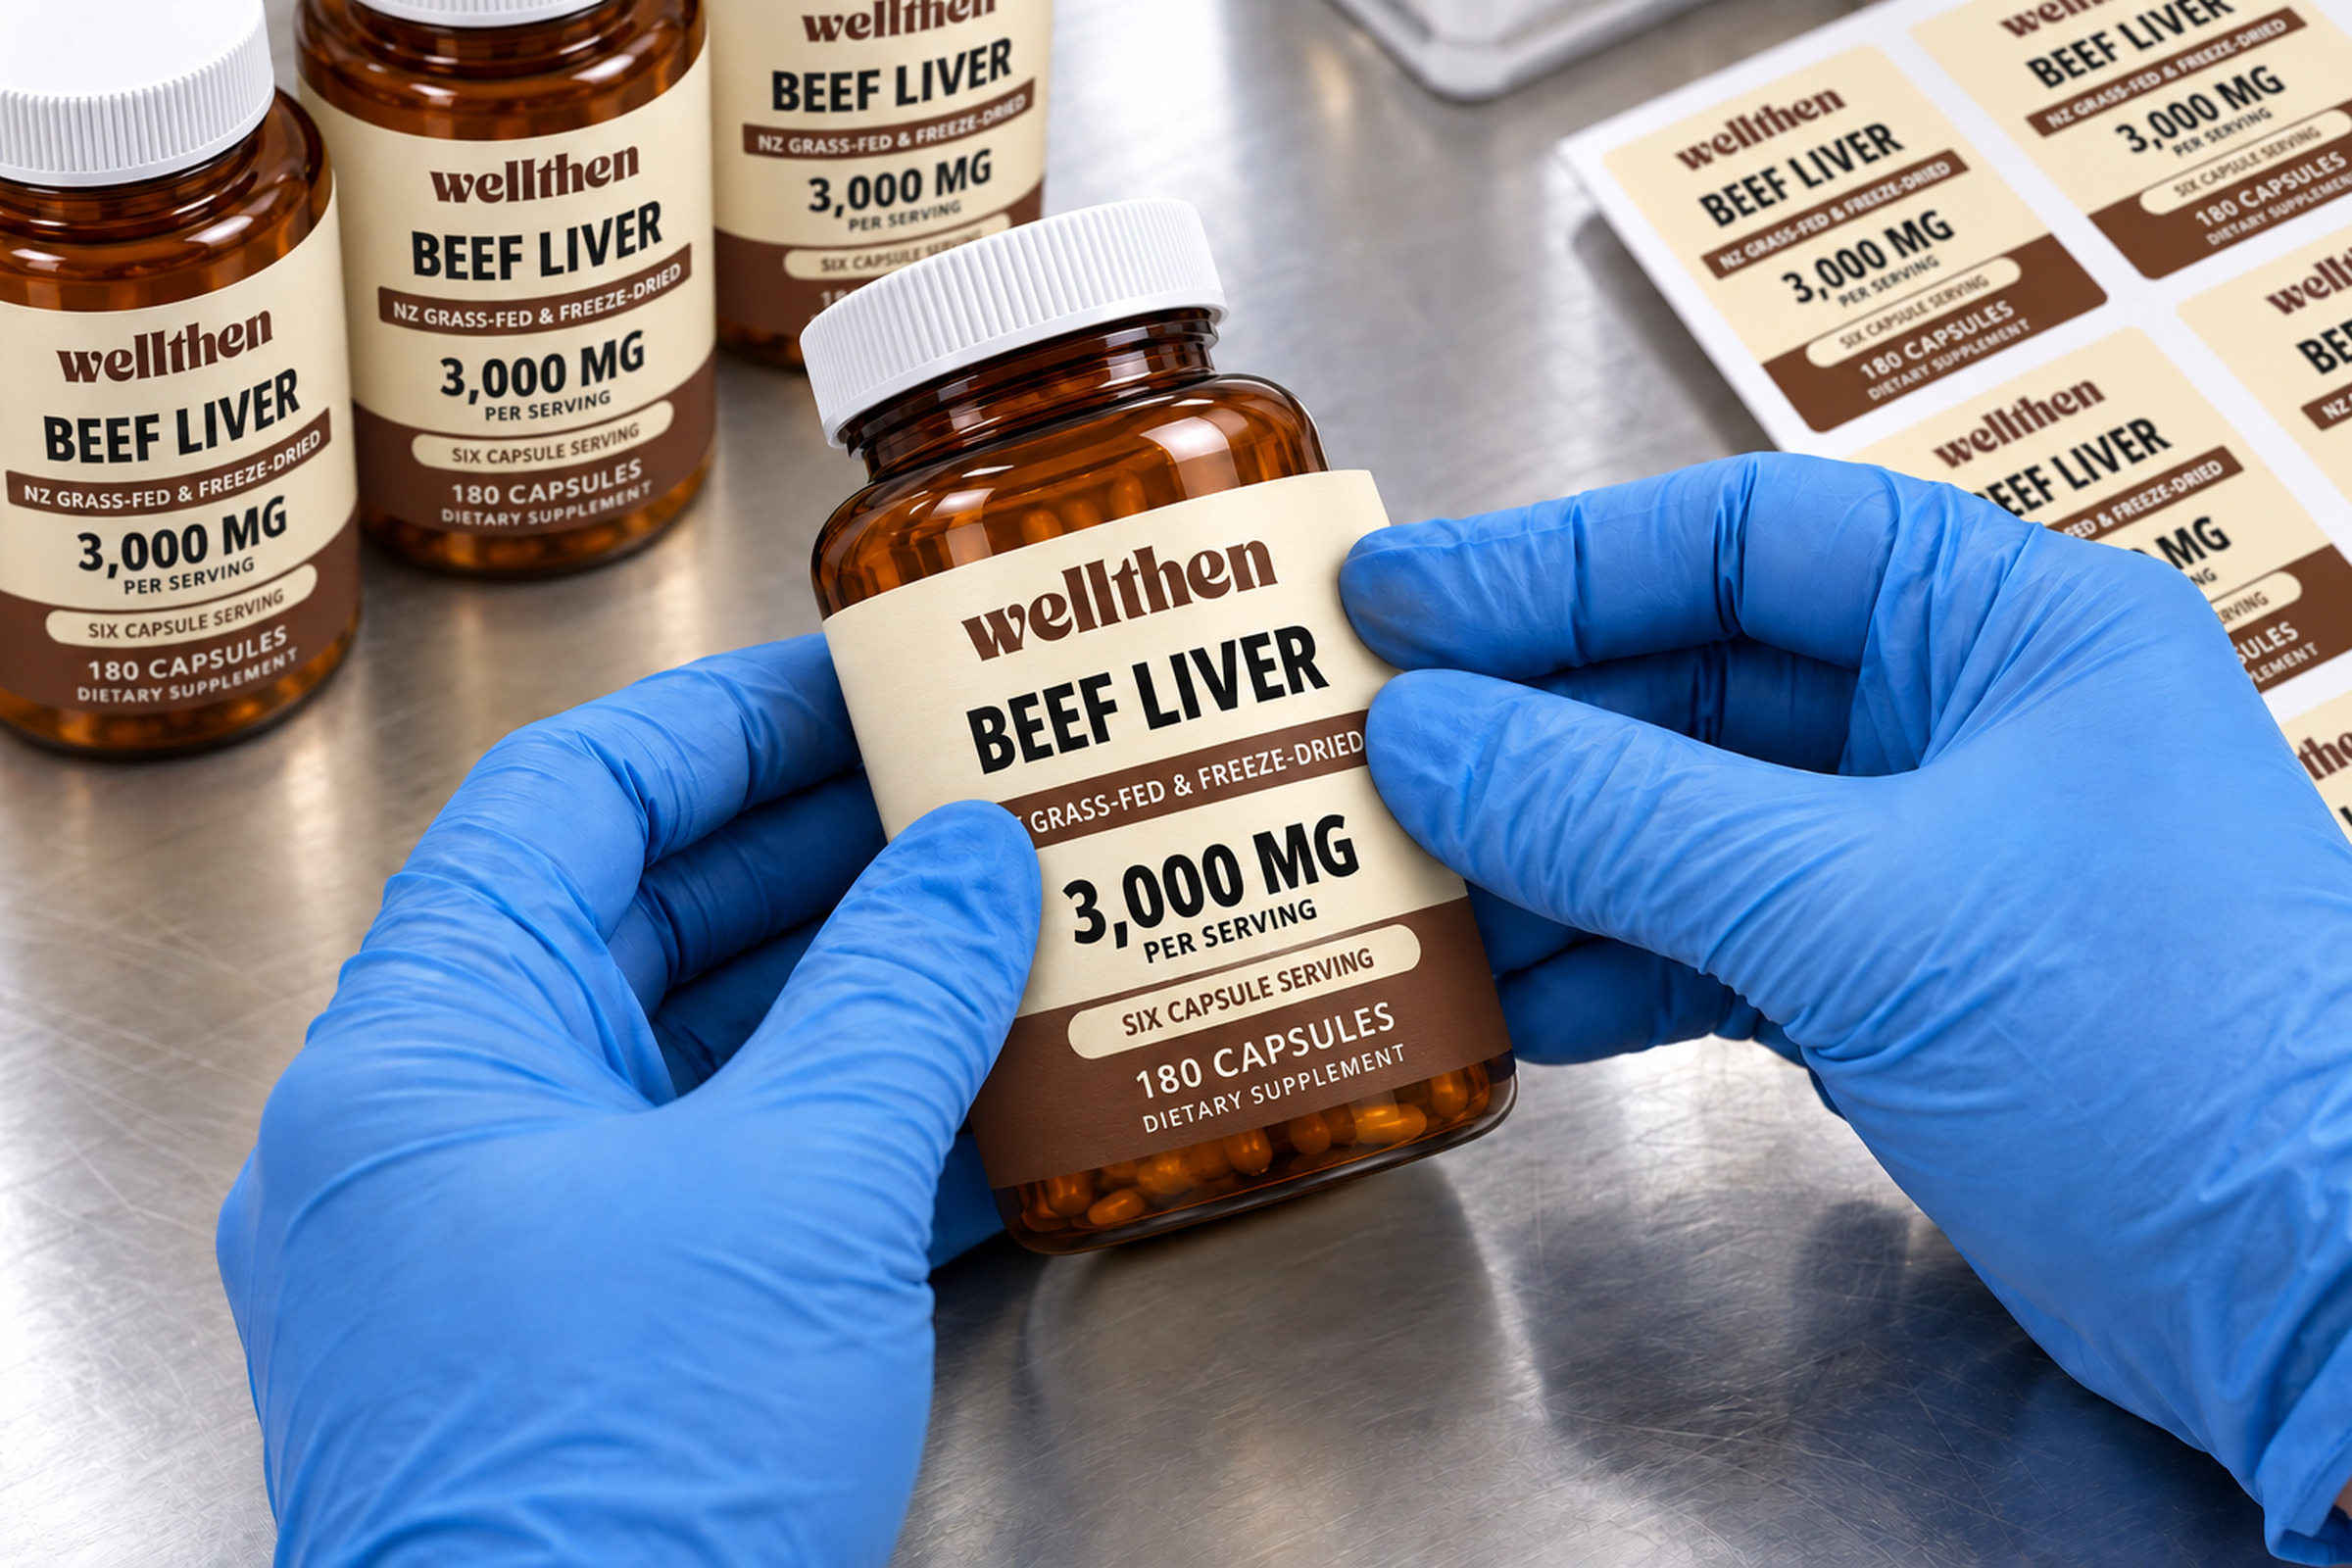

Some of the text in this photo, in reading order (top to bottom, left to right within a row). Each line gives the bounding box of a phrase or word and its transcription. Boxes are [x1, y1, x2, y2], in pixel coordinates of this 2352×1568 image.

[772, 37, 1012, 113] BEEF LIVER
[2025, 30, 2118, 89] BEEF
[2045, 18, 2288, 128] NZ GRASS-FED & FREEZE-DRIED
[759, 93, 1026, 154] NZ GRASS-FED & FREEZE-DRIED
[1674, 88, 1848, 172] wellthen
[2114, 65, 2287, 155] 3,000 MG
[2172, 107, 2274, 158] PER SERVING
[429, 145, 641, 203] wellthen
[808, 148, 993, 219] 3,000 MG
[1697, 122, 1906, 228] BEEF LIVER
[2173, 179, 2199, 198] SIX
[2195, 150, 2348, 227] 180 CAPSULES
[412, 200, 663, 281] BEEF LIVER
[848, 200, 962, 232] PER SERVING
[1719, 160, 1952, 271] NZ GRASS-FED & FREEZE-DRIED
[2206, 211, 2268, 246] DIETARY
[820, 258, 848, 273] SIX
[1781, 209, 1956, 306] 3,000 MG
[1838, 253, 1940, 310] PER SERVING
[2265, 246, 2352, 317] well
[393, 262, 682, 328] NZ GRASS-FED & FREEZE-DRIED
[1838, 272, 1991, 352] SIX CAPSULE SERVING
[56, 310, 274, 384] wellthen
[440, 329, 645, 406] 3,000 MG
[1860, 299, 2016, 381] 180 CAPSULES
[1867, 317, 2033, 403] DIETARY SUPPLEMENT
[2295, 318, 2352, 375] BE
[43, 368, 301, 465] BEEF LIVER
[484, 389, 612, 421] PER SERVING
[1932, 378, 2107, 470] wellthen
[2321, 398, 2351, 419] NZ
[24, 428, 322, 511] NZ GRASS-FED & FREEZE-DRIED
[452, 422, 640, 465] SIX CAPSULE SERVING
[1974, 416, 2173, 517] EEF LIVER
[441, 479, 653, 526] DIETARY SUPPLEMENT
[451, 458, 643, 506] 180 CAPSULES
[2096, 459, 2225, 528] & FREEZE-DRIED
[76, 495, 288, 580] 3,000 MG
[2154, 515, 2231, 570] MG
[123, 556, 256, 596] PER SERVING
[960, 538, 1279, 662] wellthen
[2217, 591, 2270, 624] RVING
[88, 588, 285, 639] SIX CAPSULE SERVING
[77, 647, 299, 704] DIETARY SUPPLEMENT
[87, 624, 288, 682] 180 CAPSULES
[2251, 641, 2319, 684] LEMENT
[965, 624, 1331, 776] BEEF LIVER
[1030, 730, 1364, 834] GRASS-FED & FREEZE-DRIED
[1062, 813, 1361, 951] 3,000 MG
[1143, 898, 1319, 964] PER SERVING
[1121, 947, 1376, 1038] SIX CAPSULE SERVING
[1136, 1001, 1396, 1101] 180 CAPSULES
[1143, 1042, 1409, 1135] DIETARY SUPPLEMENT
